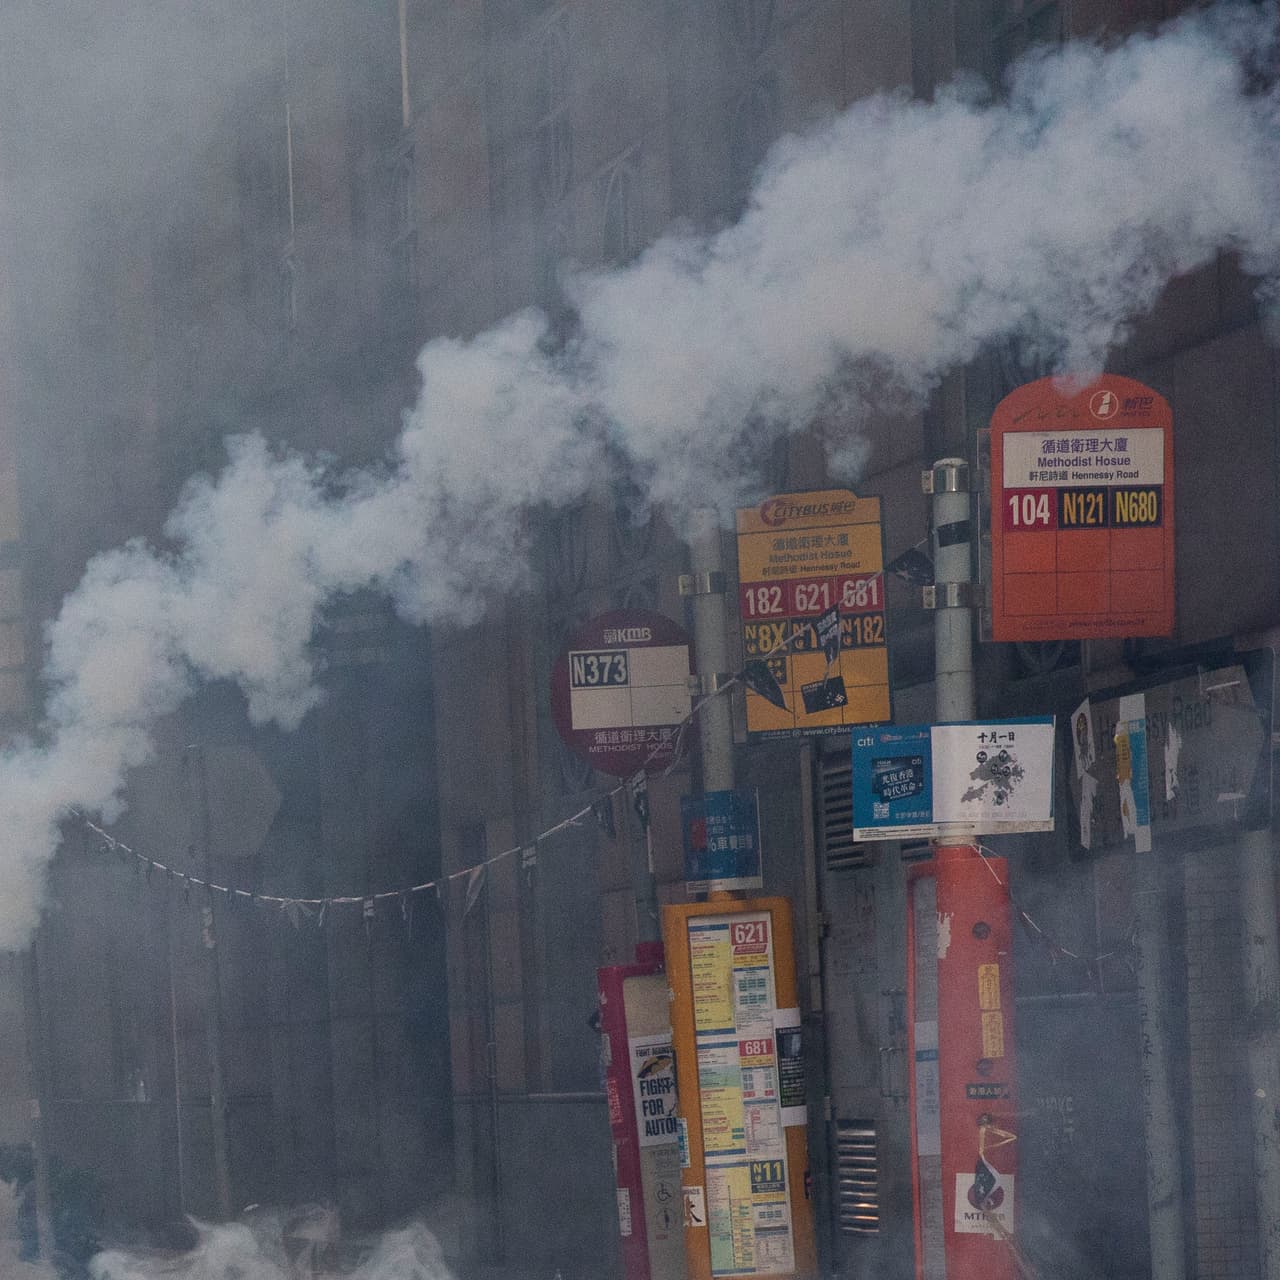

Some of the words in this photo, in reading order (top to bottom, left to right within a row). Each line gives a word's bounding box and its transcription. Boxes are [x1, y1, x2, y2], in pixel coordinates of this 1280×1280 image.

[1037, 456, 1092, 468] Methodist
[1095, 455, 1131, 466] Hosue
[1029, 470, 1069, 482] 軒尼詩道
[1071, 471, 1114, 481] Hennessy
[1116, 470, 1139, 479] Road
[774, 503, 829, 518] CITYBUS
[1009, 494, 1050, 526] 104
[1063, 492, 1104, 524] N121
[1115, 491, 1158, 523] N680
[769, 551, 818, 563] Methodist
[800, 562, 838, 573] Hennessy
[840, 560, 860, 569] Road
[746, 586, 783, 615] 182
[795, 582, 830, 611] 621
[843, 578, 878, 608] 681
[618, 627, 652, 643] KMB
[842, 615, 884, 645] N182
[573, 654, 627, 685] N373
[857, 736, 874, 747] citi
[977, 731, 1016, 744] 十月一日
[589, 743, 642, 753] METHODIST
[735, 922, 765, 944] 621
[745, 1041, 768, 1055] 681
[640, 1077, 671, 1097] FIGHT
[642, 1098, 665, 1117] FOR
[753, 1161, 782, 1182] N11
